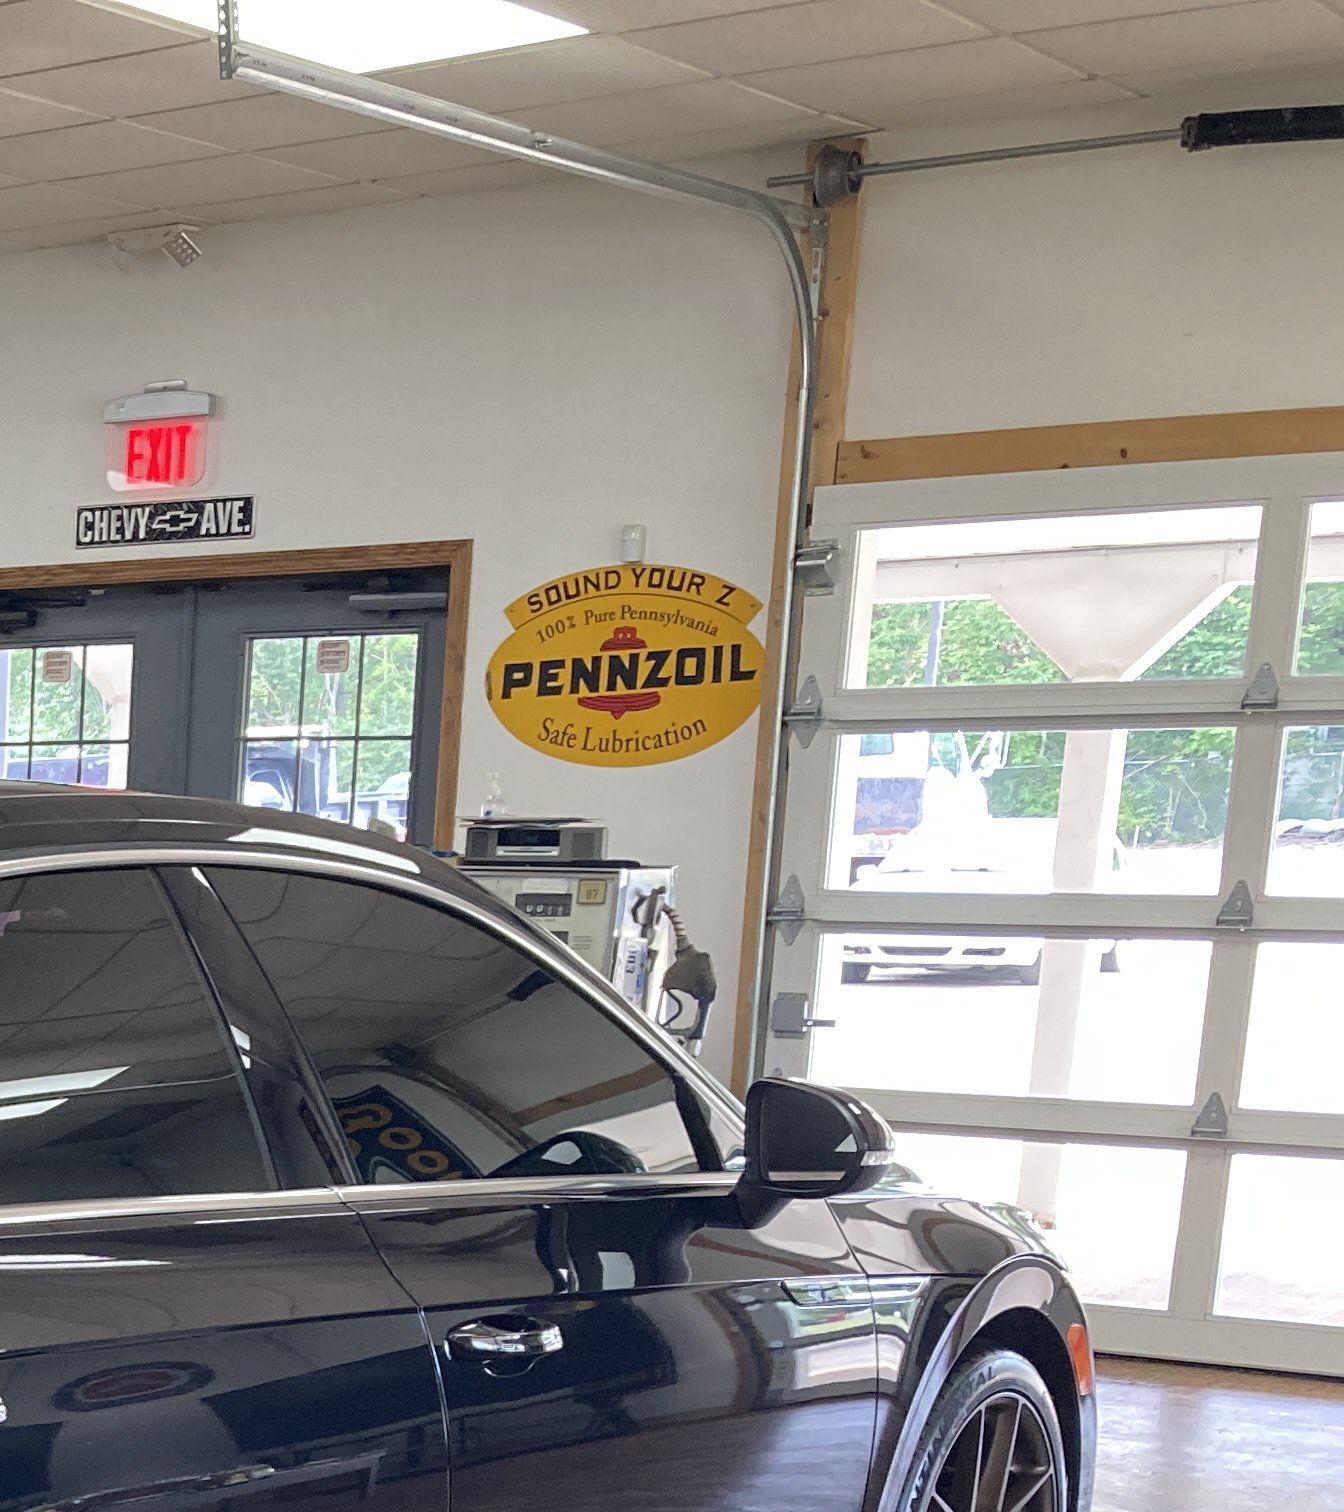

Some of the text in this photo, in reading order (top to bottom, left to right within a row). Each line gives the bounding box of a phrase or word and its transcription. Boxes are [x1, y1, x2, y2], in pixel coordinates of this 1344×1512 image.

[127, 425, 193, 483] EXIT
[78, 500, 251, 544] CHEVY AVE.
[526, 567, 737, 614] SOUND YOUR Z
[534, 604, 720, 644] 100% Pure Pennsylvania
[500, 643, 758, 700] PENNZOIL
[537, 716, 708, 754] Safe Lubrication
